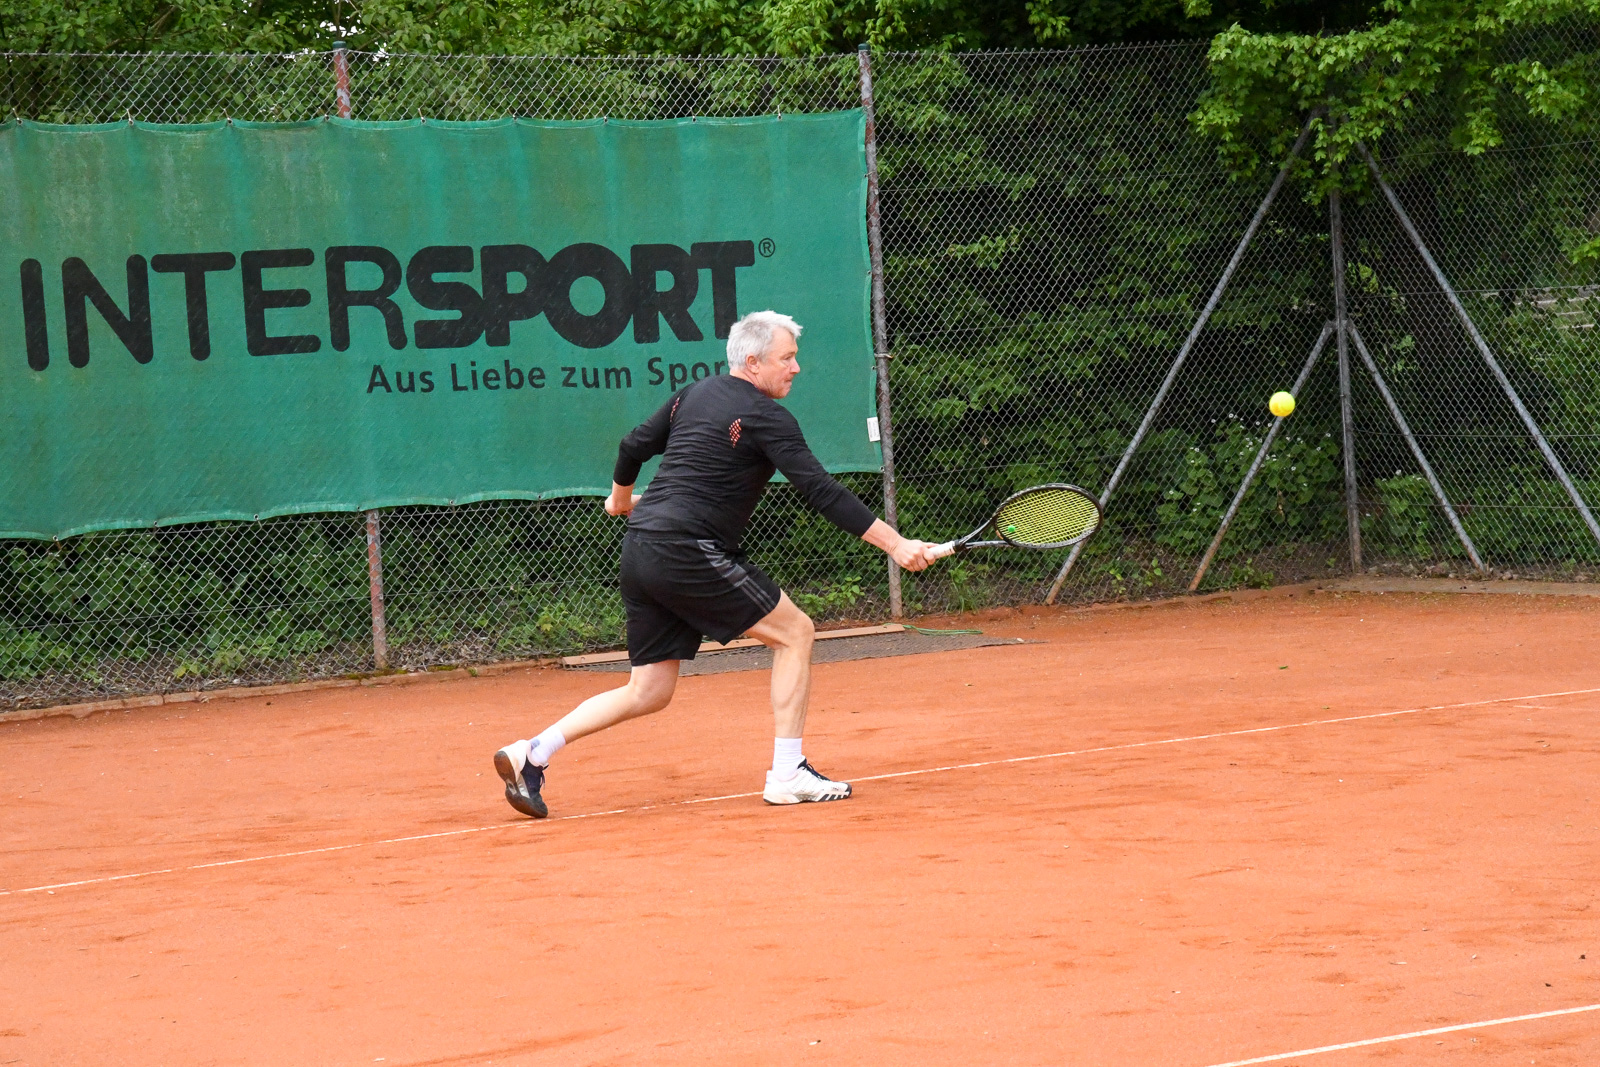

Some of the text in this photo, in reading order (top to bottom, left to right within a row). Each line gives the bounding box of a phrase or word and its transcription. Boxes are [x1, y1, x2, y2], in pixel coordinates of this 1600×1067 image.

[20, 240, 755, 371] INTERSPORT
[367, 356, 727, 394] Aus Liebe zum Spor
